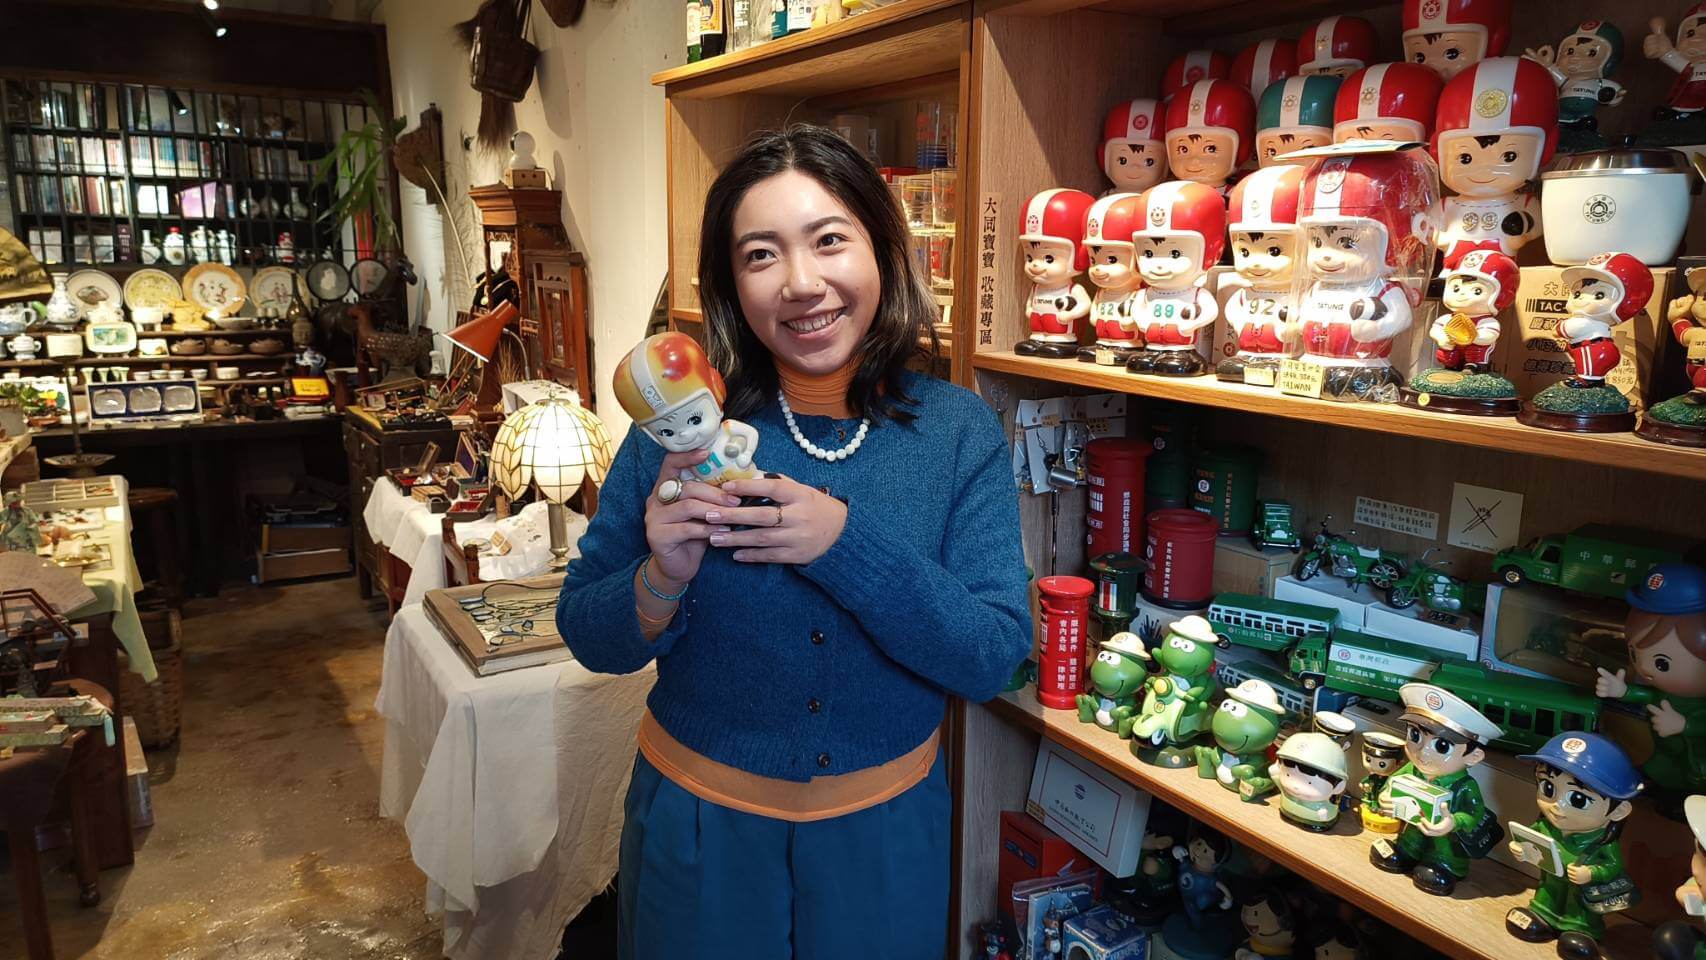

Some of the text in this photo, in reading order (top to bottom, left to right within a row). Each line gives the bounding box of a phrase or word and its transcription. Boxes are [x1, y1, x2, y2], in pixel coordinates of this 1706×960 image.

[1462, 211, 1498, 232] 99
[980, 197, 997, 345] 大同寶寶 收藏專區
[1153, 304, 1174, 318] 89
[1249, 298, 1276, 315] 92
[1317, 302, 1344, 311] TATUNG
[1539, 301, 1568, 312] TAC-
[1282, 381, 1311, 391] TAIWAN
